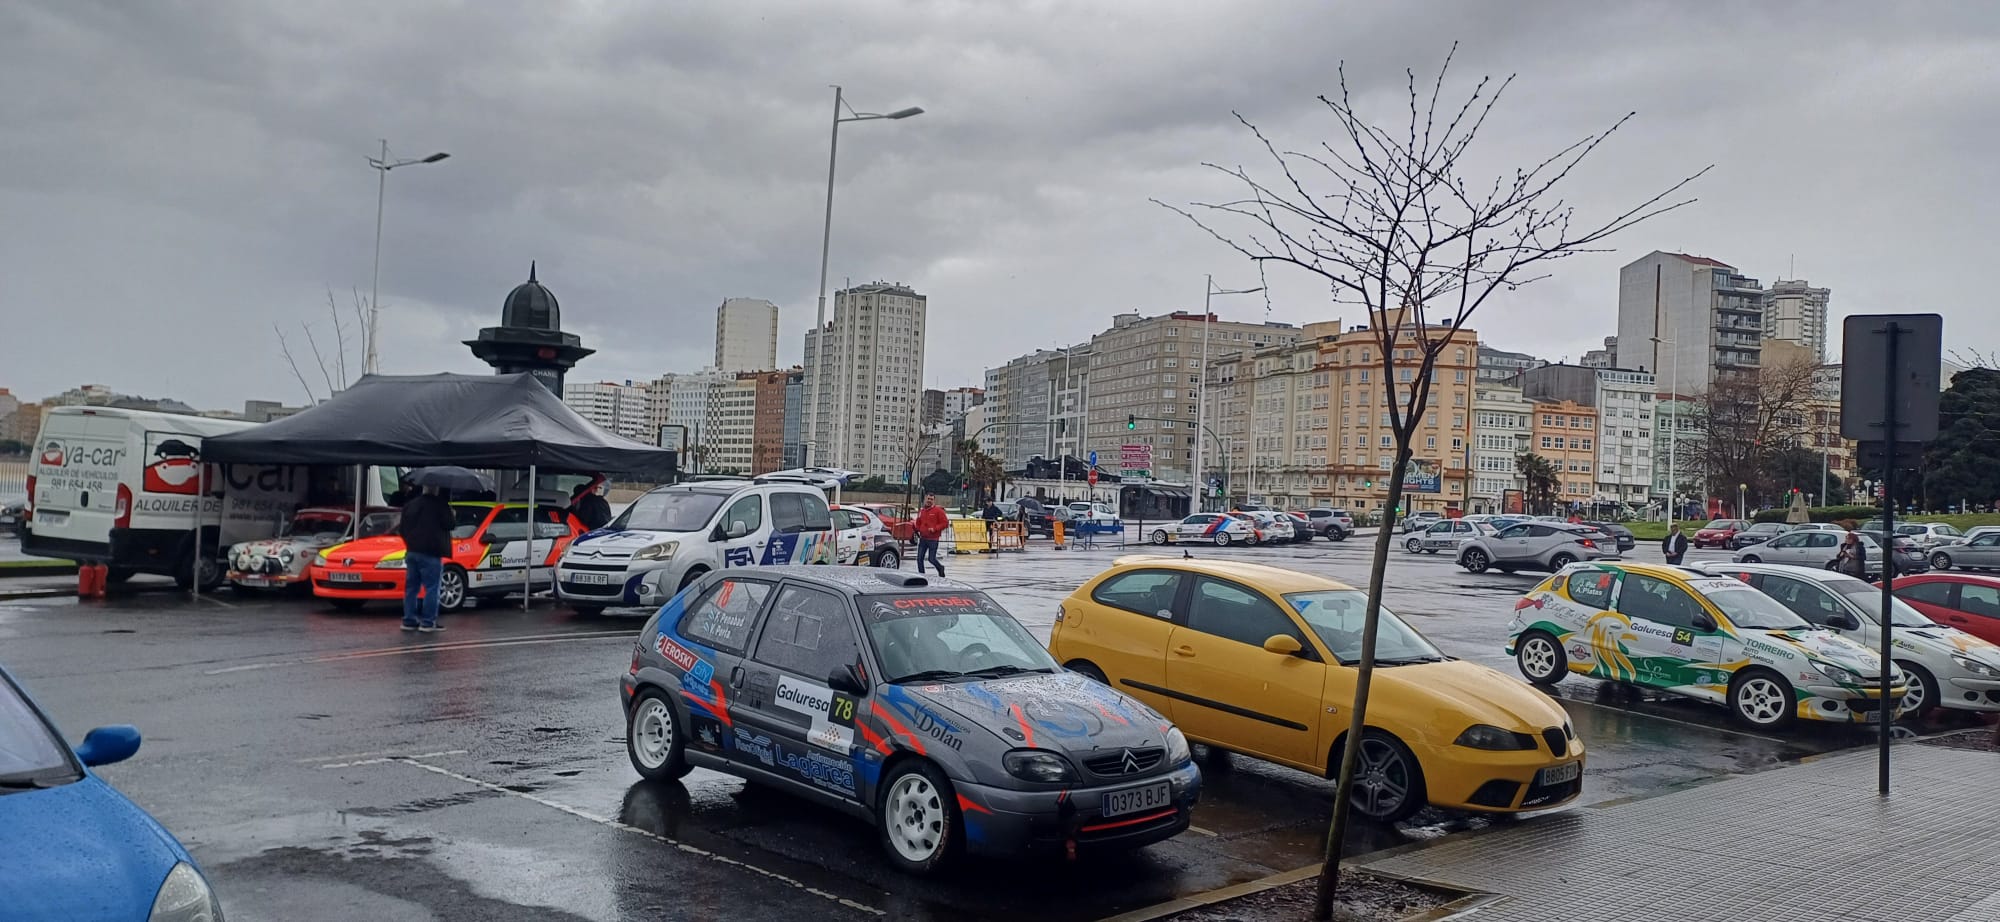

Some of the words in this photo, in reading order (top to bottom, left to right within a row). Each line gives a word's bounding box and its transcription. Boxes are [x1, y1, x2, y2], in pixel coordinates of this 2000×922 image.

[51, 479, 67, 488] 981
[134, 499, 198, 512] ALQUILER
[203, 500, 221, 512] DE
[716, 581, 735, 608] 78
[902, 607, 982, 616] RACING
[1630, 622, 1672, 638] Galuresa
[1676, 631, 1691, 643] 54
[1741, 651, 1774, 665] RECAMBIOS
[1743, 646, 1759, 655] AUTO
[1746, 638, 1795, 660] TORREIRO
[664, 643, 693, 669] EROSKI
[694, 665, 709, 681] city
[776, 683, 830, 712] Galuresa
[835, 697, 853, 720] 78
[919, 713, 963, 752] Dolan
[776, 744, 855, 790] Lagarea
[1112, 791, 1142, 812] 0373
[1146, 786, 1167, 806] BJF
